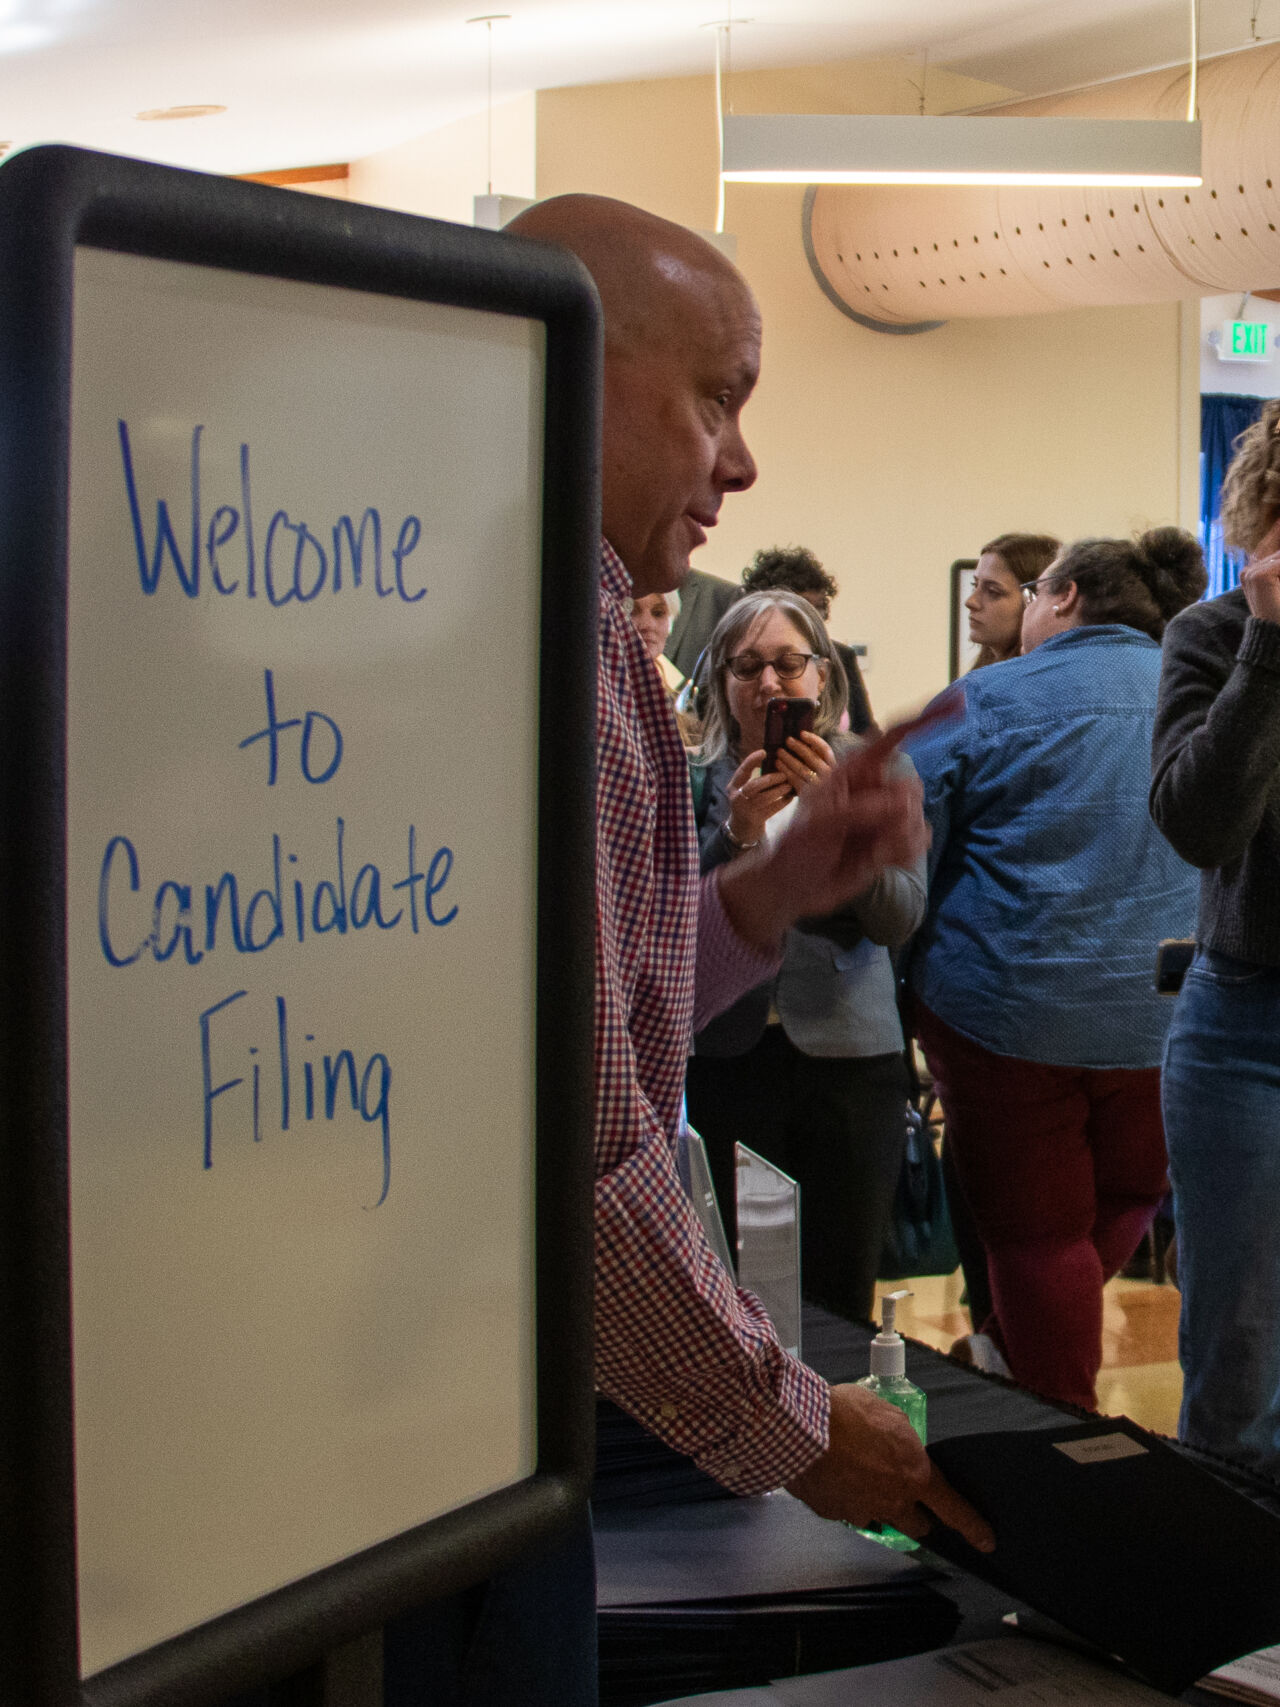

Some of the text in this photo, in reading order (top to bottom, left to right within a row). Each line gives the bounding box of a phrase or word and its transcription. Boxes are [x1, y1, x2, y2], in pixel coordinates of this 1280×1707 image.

[1232, 322, 1268, 354] EXIT
[118, 419, 427, 606] Welcome
[239, 669, 343, 786] to
[98, 817, 459, 967] Candidate
[201, 990, 392, 1211] Filing
